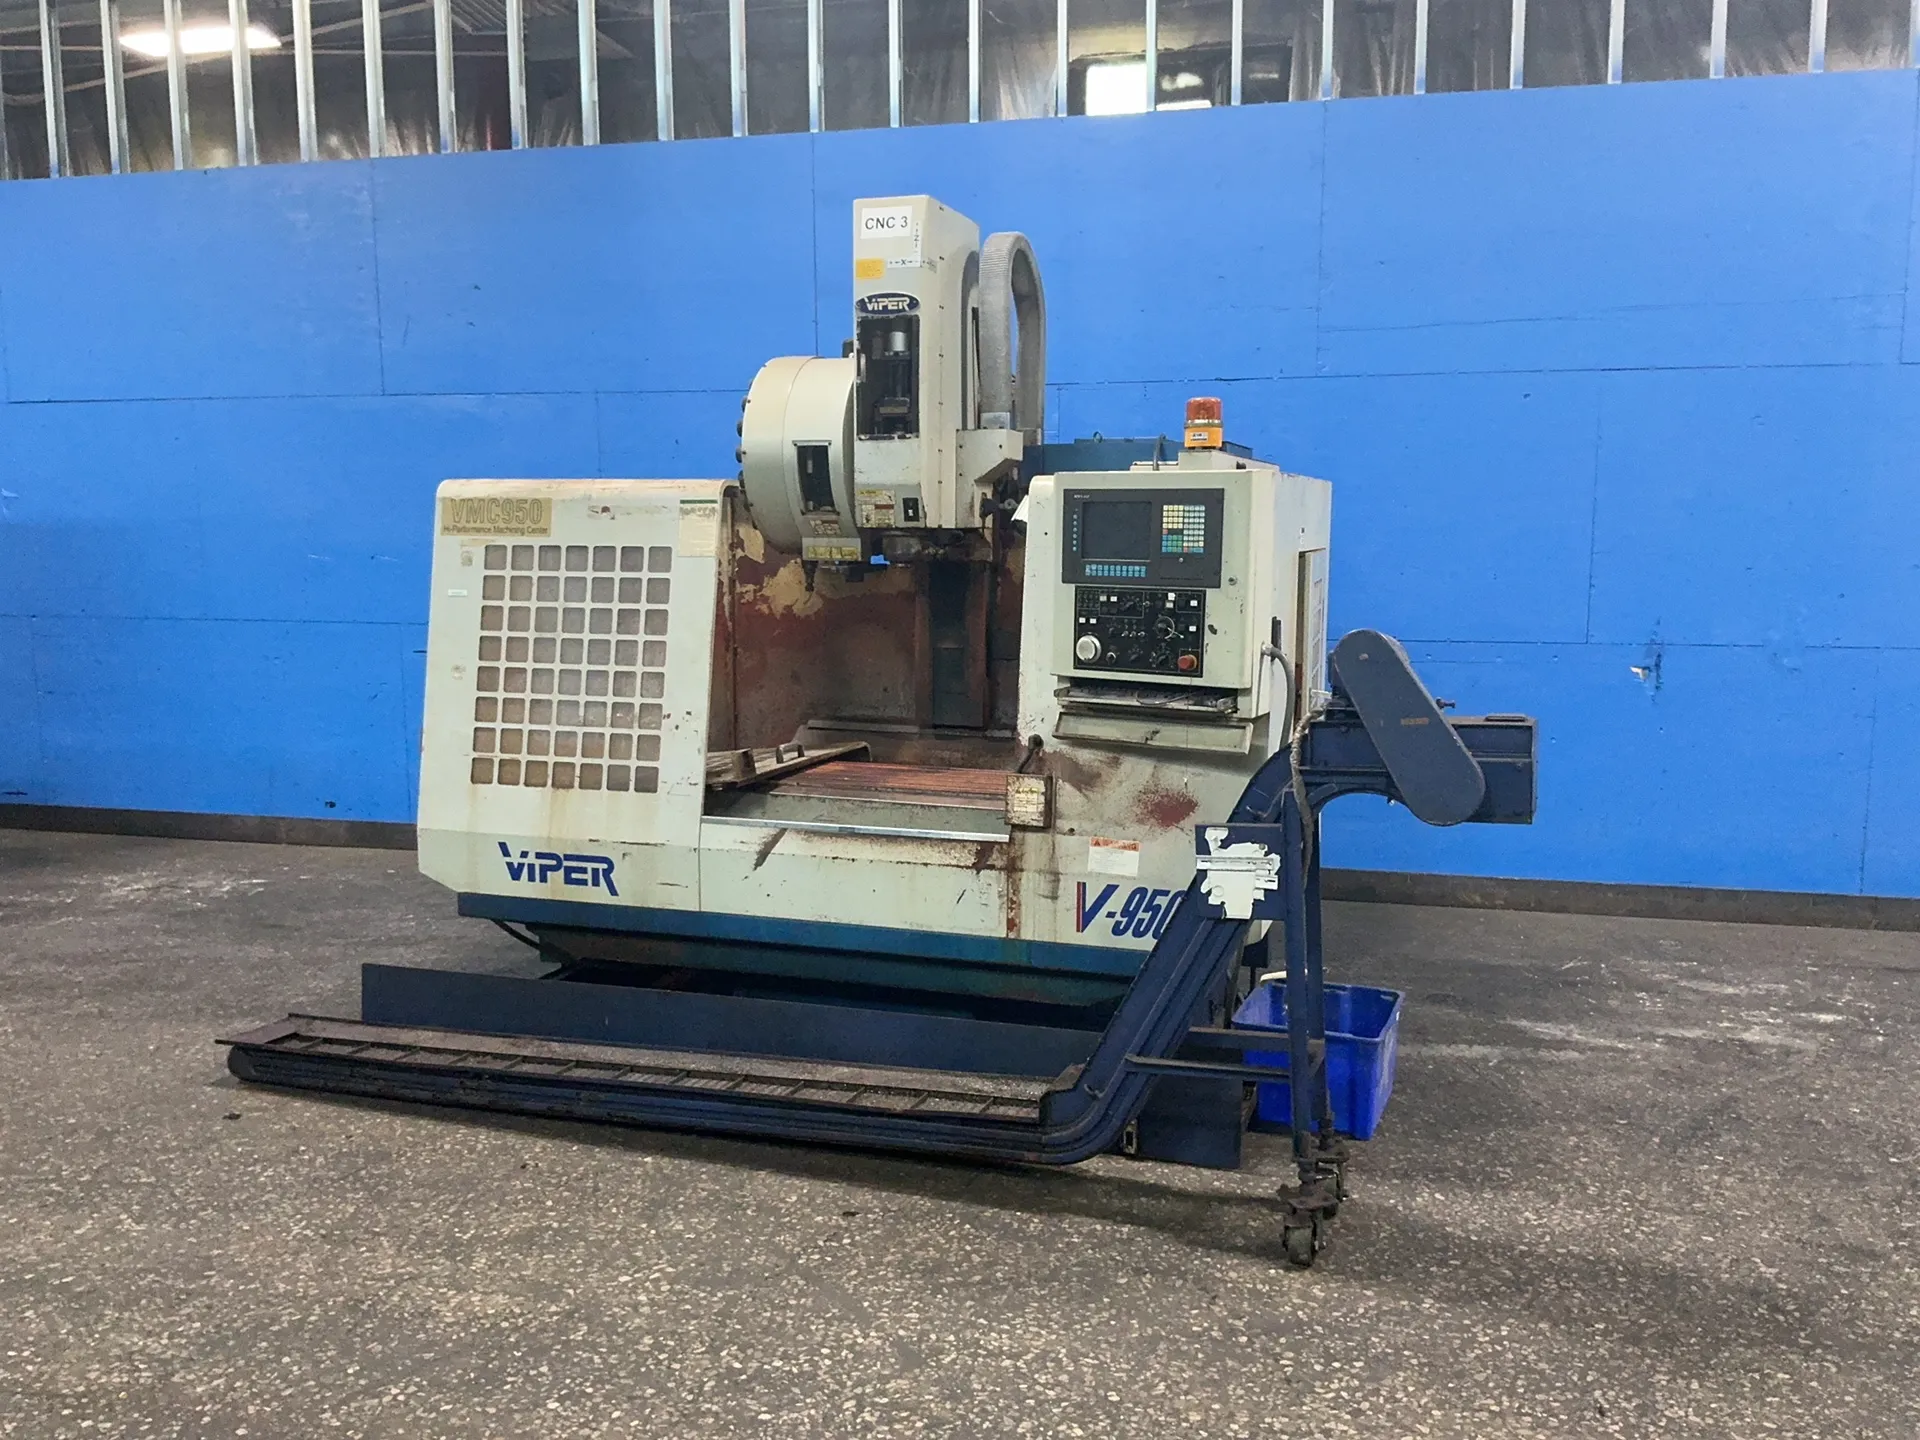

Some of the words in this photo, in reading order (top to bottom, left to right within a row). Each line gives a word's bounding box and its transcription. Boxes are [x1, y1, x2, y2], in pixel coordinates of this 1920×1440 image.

[865, 216, 896, 230] CNC
[900, 215, 908, 228] 3
[450, 498, 543, 525] VMC950
